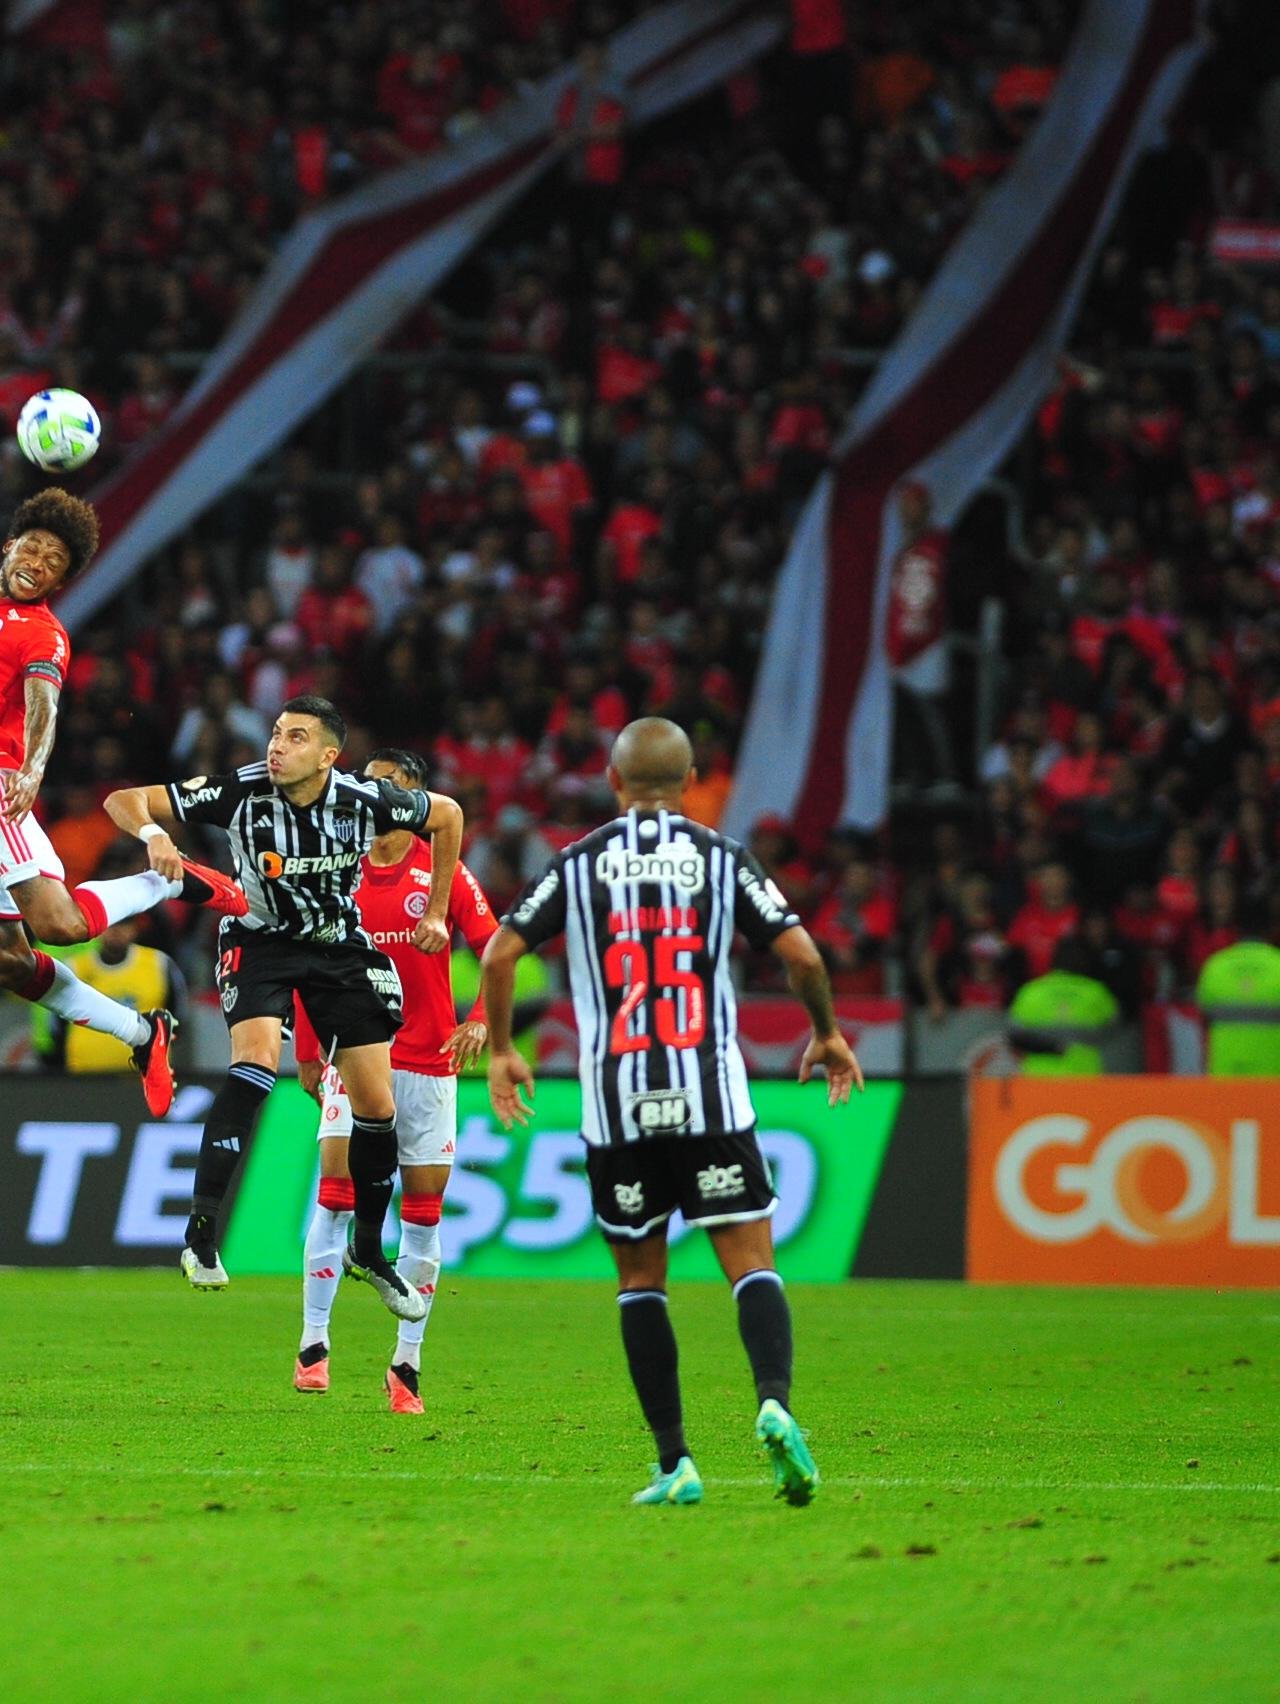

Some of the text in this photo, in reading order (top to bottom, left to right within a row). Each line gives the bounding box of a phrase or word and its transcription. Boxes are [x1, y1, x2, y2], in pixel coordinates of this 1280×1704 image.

[191, 786, 223, 804] MRV
[284, 852, 359, 875] BETANO
[625, 854, 697, 888] bmg
[221, 946, 242, 977] 21
[371, 980, 401, 996] TRUC
[603, 935, 706, 1056] 25
[640, 1099, 685, 1127] BH
[994, 1112, 1280, 1246] GOL
